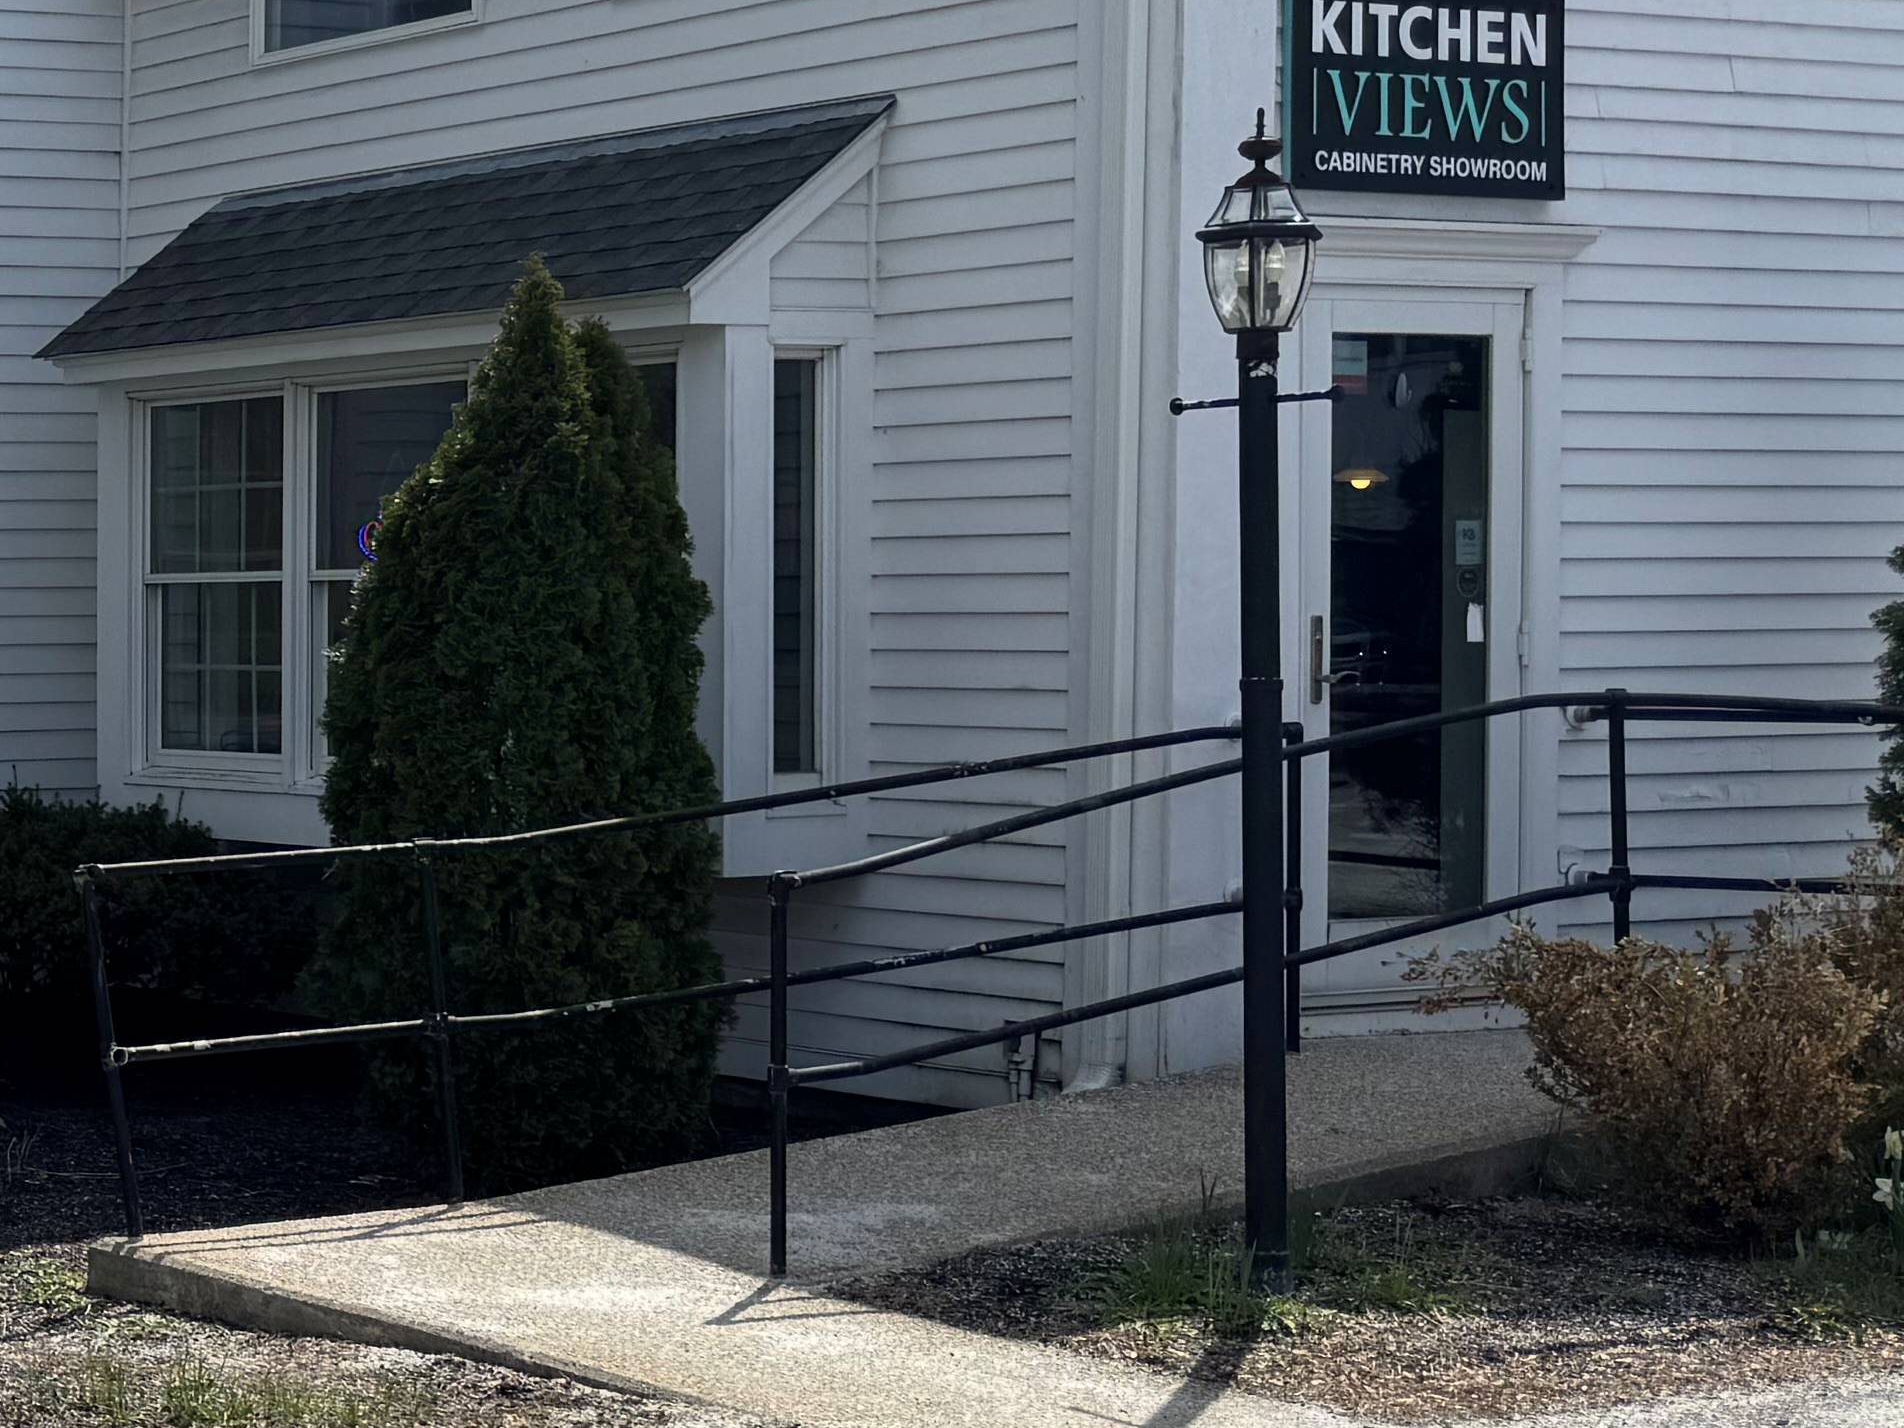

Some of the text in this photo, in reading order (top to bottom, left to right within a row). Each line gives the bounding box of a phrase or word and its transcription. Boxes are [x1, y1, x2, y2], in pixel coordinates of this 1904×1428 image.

[1326, 69, 1530, 144] VIEWS
[1315, 150, 1547, 182] CABINETRY SHOWROOM
